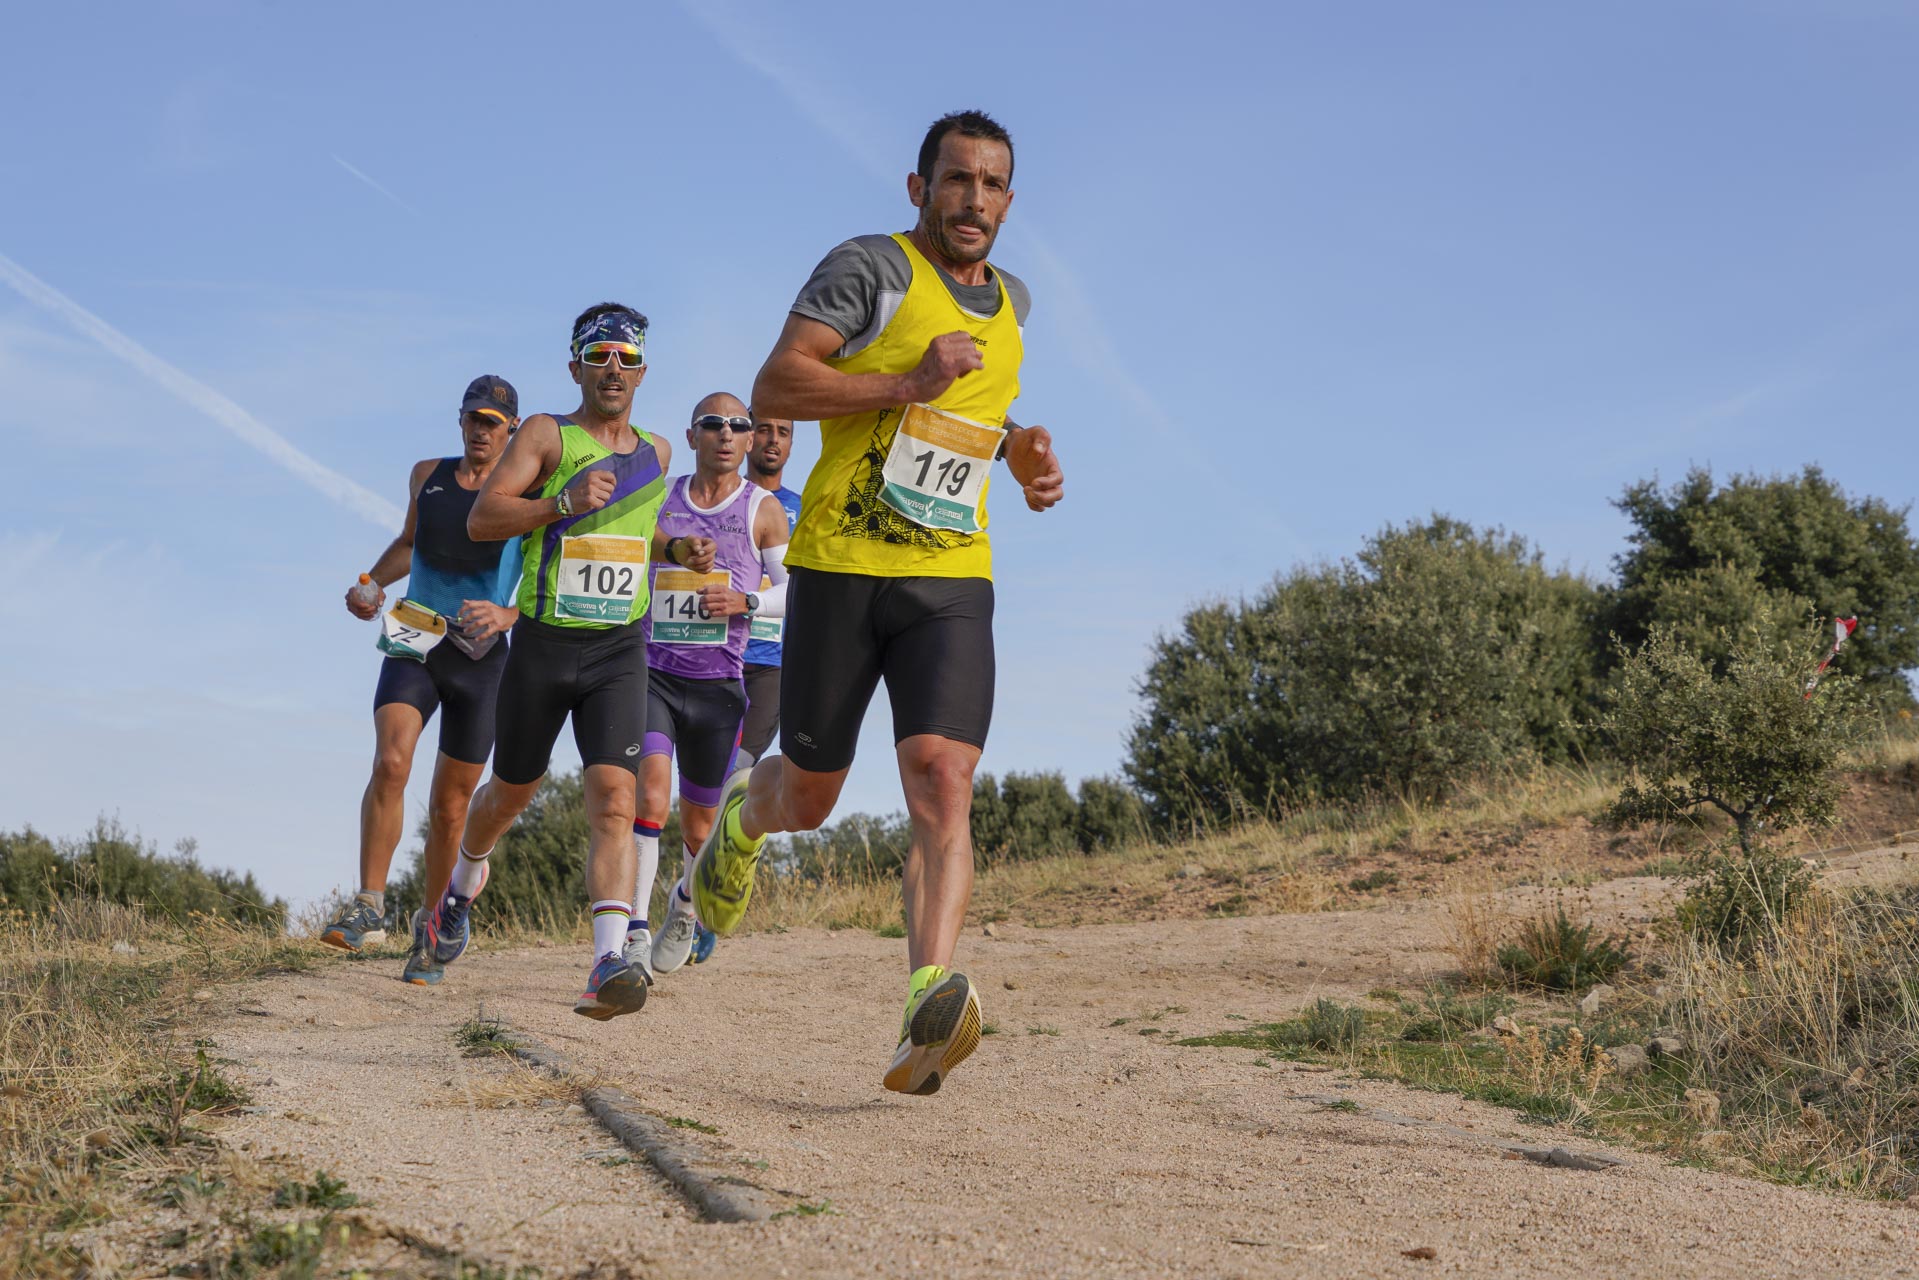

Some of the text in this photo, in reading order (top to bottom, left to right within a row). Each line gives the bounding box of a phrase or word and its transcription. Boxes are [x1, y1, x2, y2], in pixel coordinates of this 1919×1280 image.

[914, 450, 971, 497] 119
[578, 564, 633, 596] 102
[390, 626, 422, 644] 72
